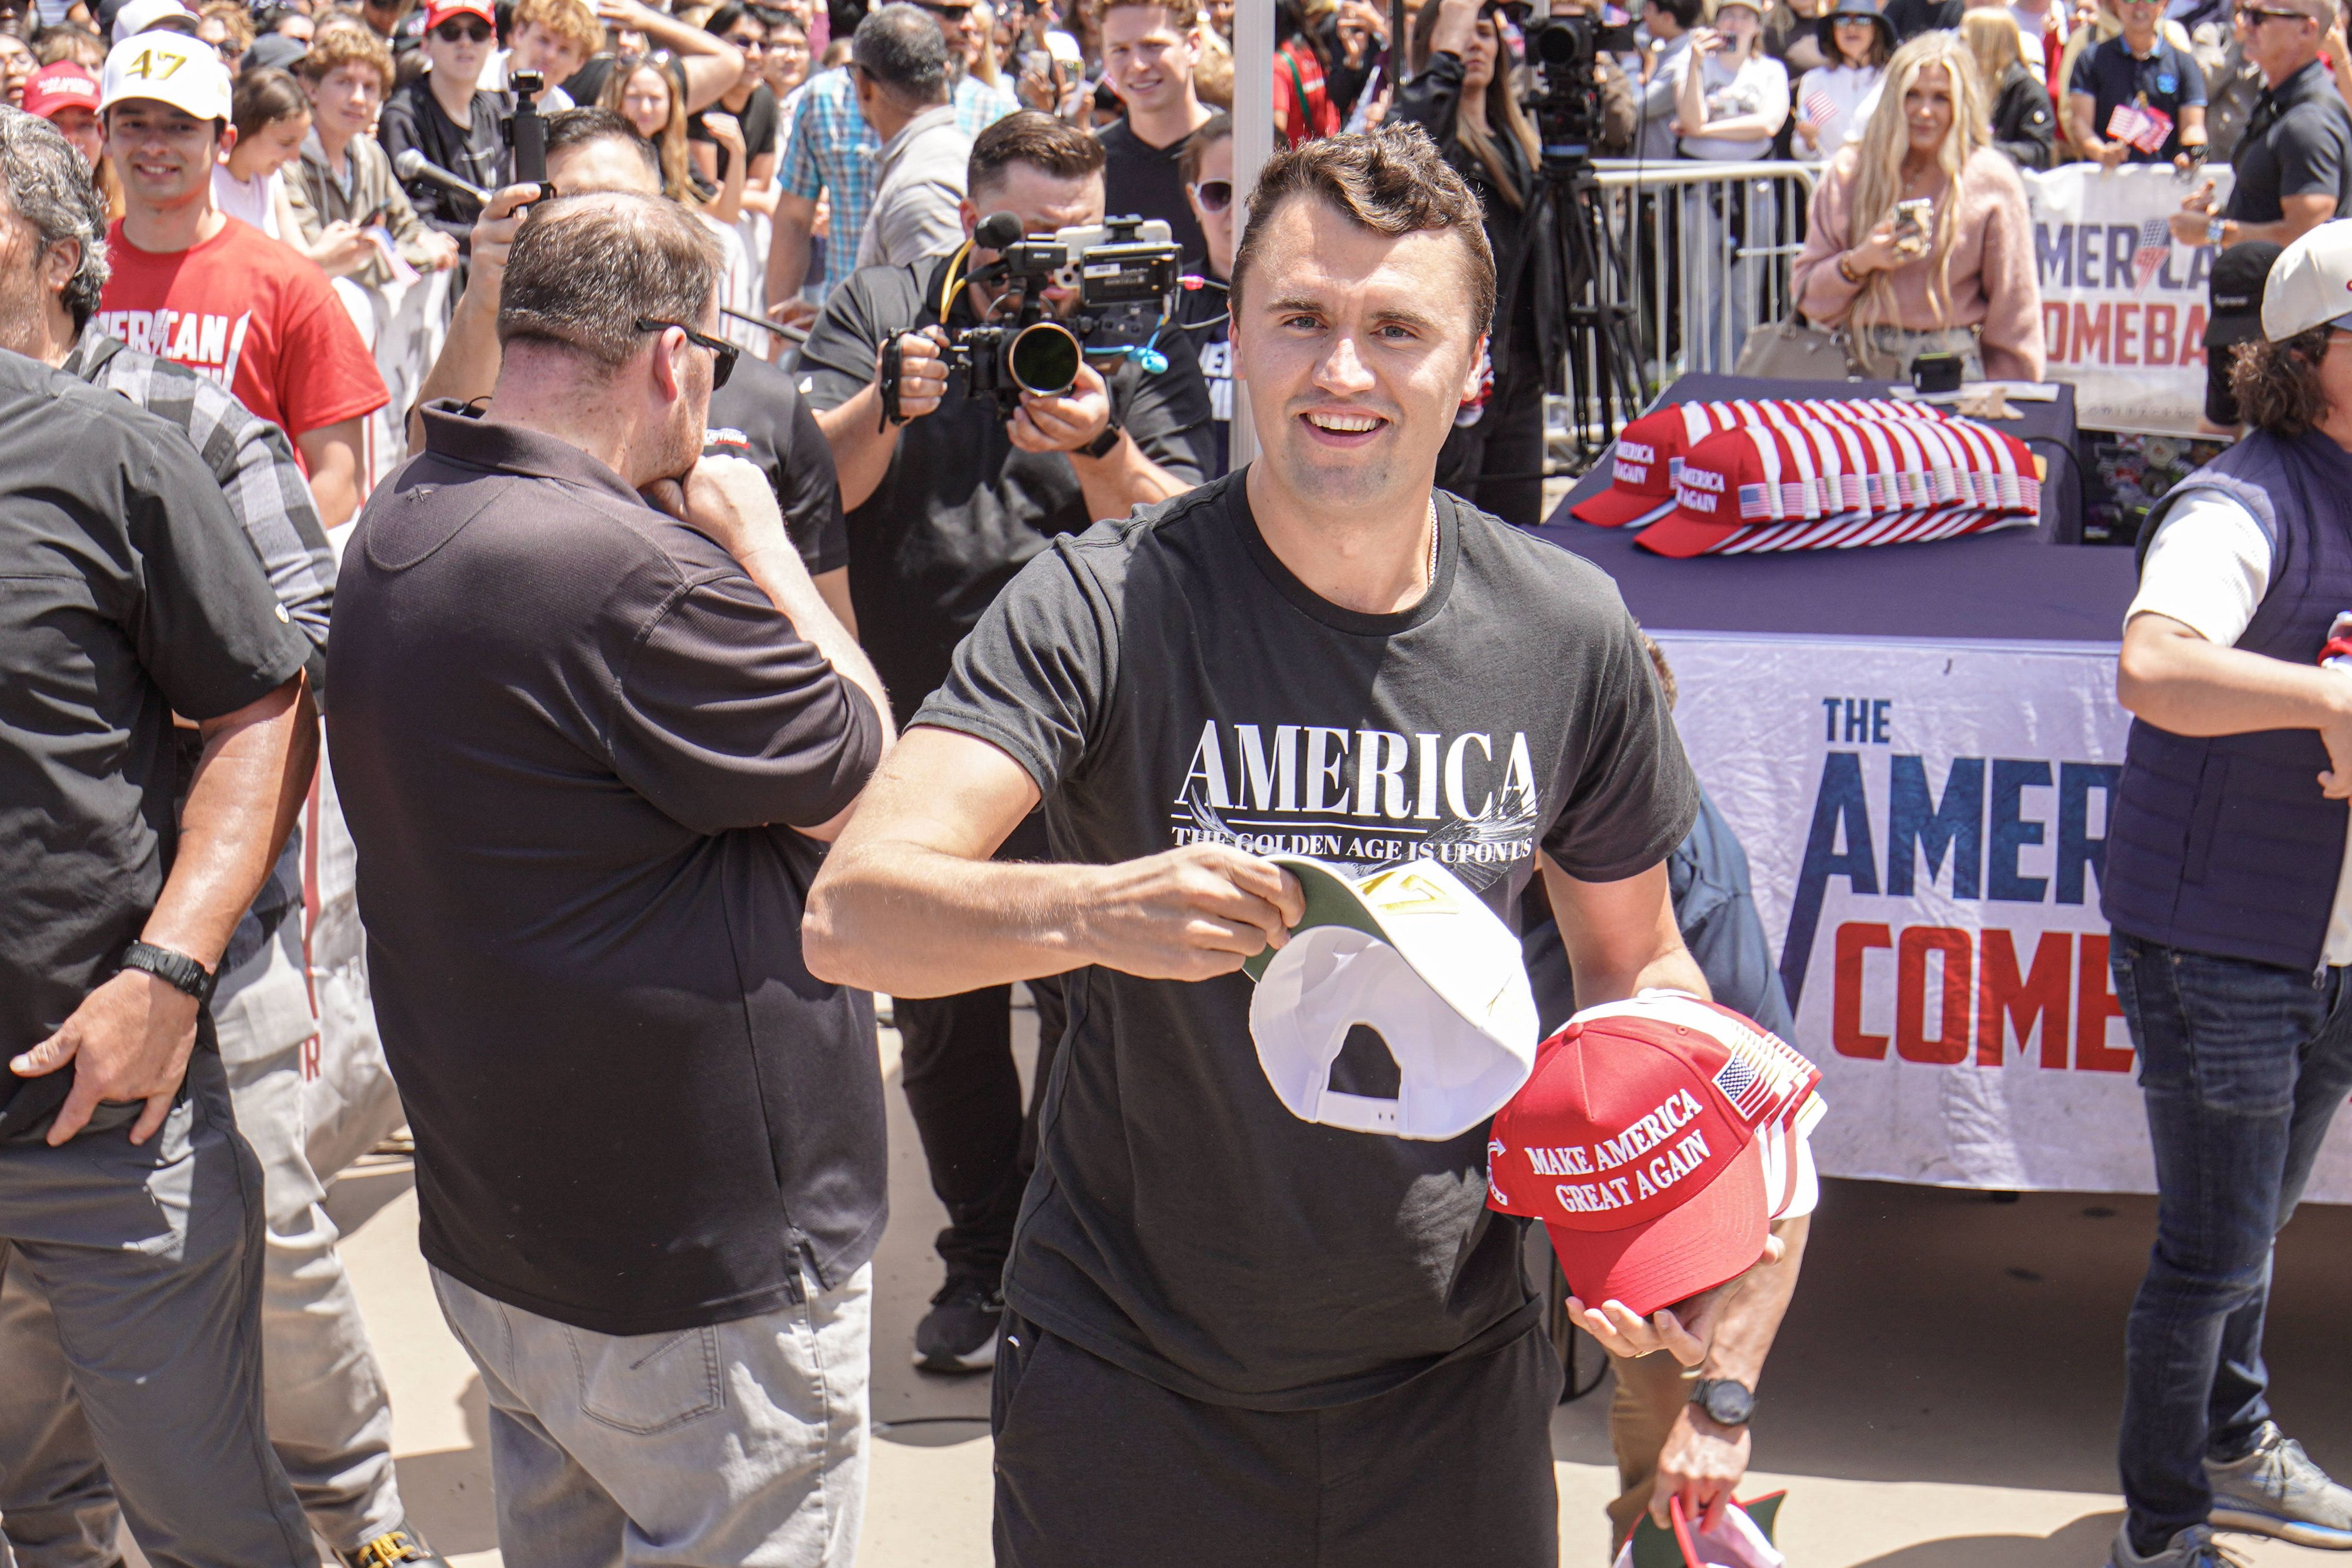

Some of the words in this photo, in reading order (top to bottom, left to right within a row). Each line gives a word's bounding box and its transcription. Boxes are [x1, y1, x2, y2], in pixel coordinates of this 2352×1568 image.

[125, 49, 187, 80] 47
[1822, 697, 1892, 744] THE
[1174, 720, 1538, 821] AMERICA
[1235, 833, 1342, 855] GOLDEN
[1345, 837, 1402, 861] AGE
[1408, 841, 1435, 861] IS
[1524, 1146, 1594, 1175] MAKE
[1594, 1088, 1703, 1172] AMERICA
[1555, 1177, 1633, 1212] GREAT
[1636, 1129, 1711, 1200] AGAIN
